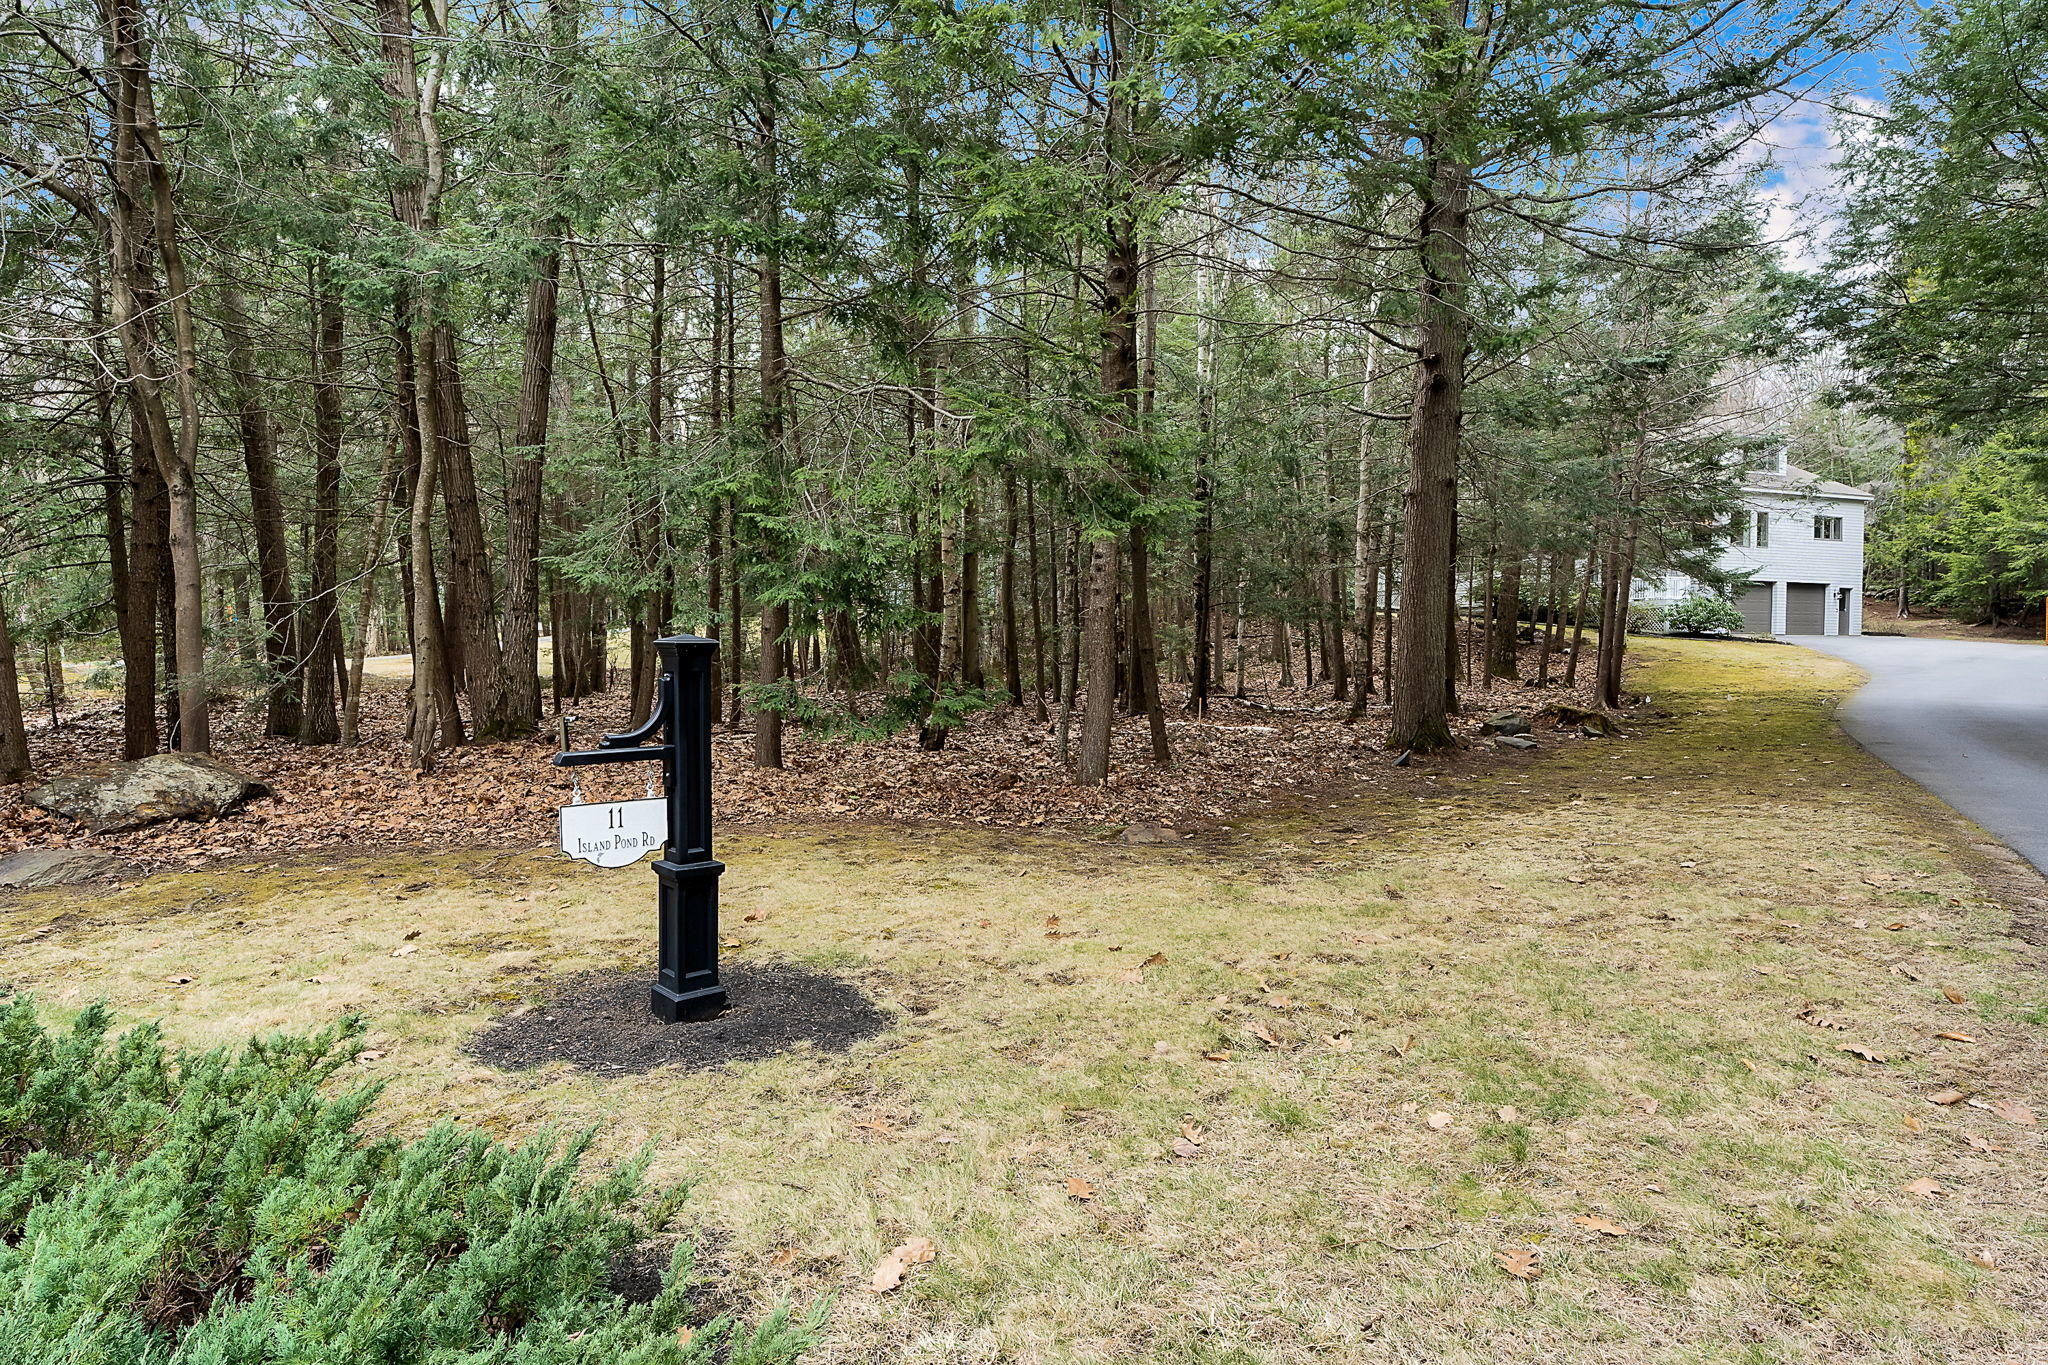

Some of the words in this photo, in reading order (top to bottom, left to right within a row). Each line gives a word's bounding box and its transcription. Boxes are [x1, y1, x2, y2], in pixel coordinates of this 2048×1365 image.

[608, 806, 624, 829] 11
[577, 837, 611, 853] ISLAND
[614, 834, 638, 850] POND
[641, 831, 655, 847] RD
